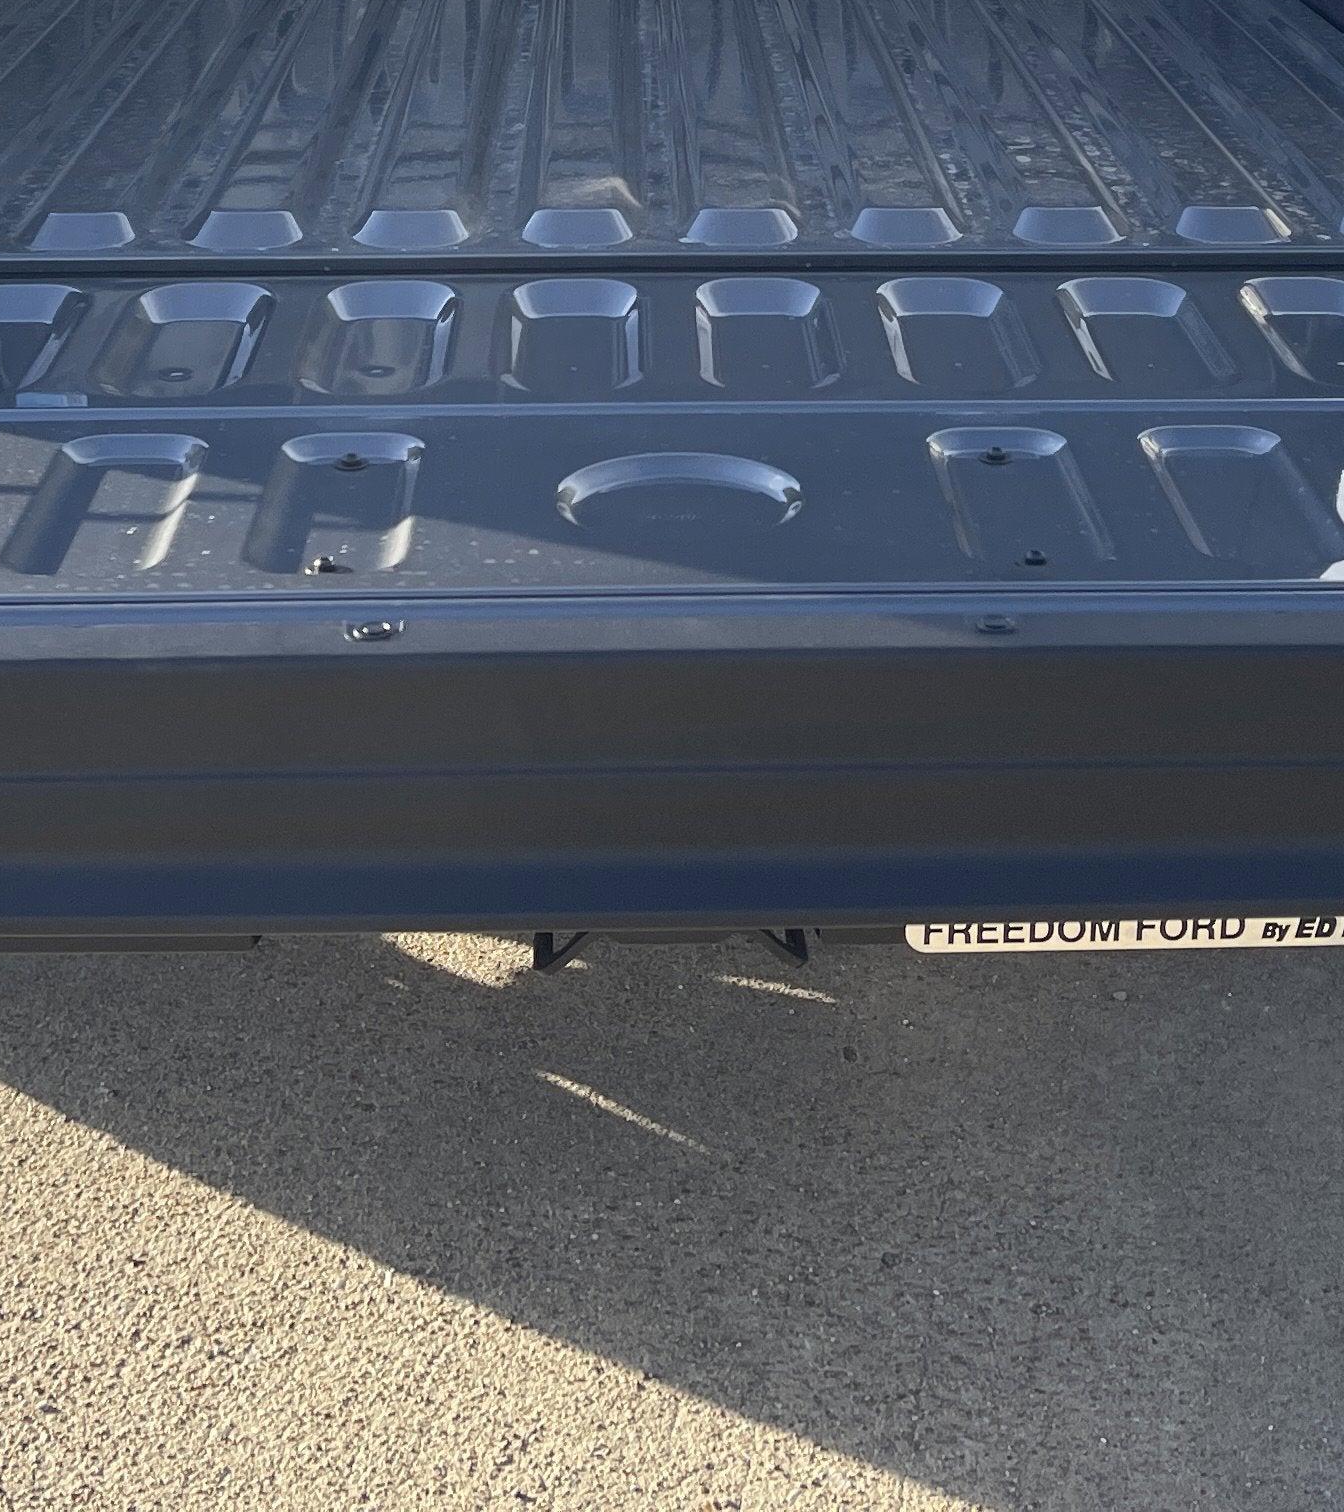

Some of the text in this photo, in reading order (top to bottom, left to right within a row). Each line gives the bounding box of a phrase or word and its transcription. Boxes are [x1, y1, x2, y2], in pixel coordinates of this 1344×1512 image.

[923, 920, 1120, 945] FREEDOM
[1136, 918, 1246, 942] FORD
[1261, 922, 1291, 942] By
[1294, 916, 1337, 939] ED
